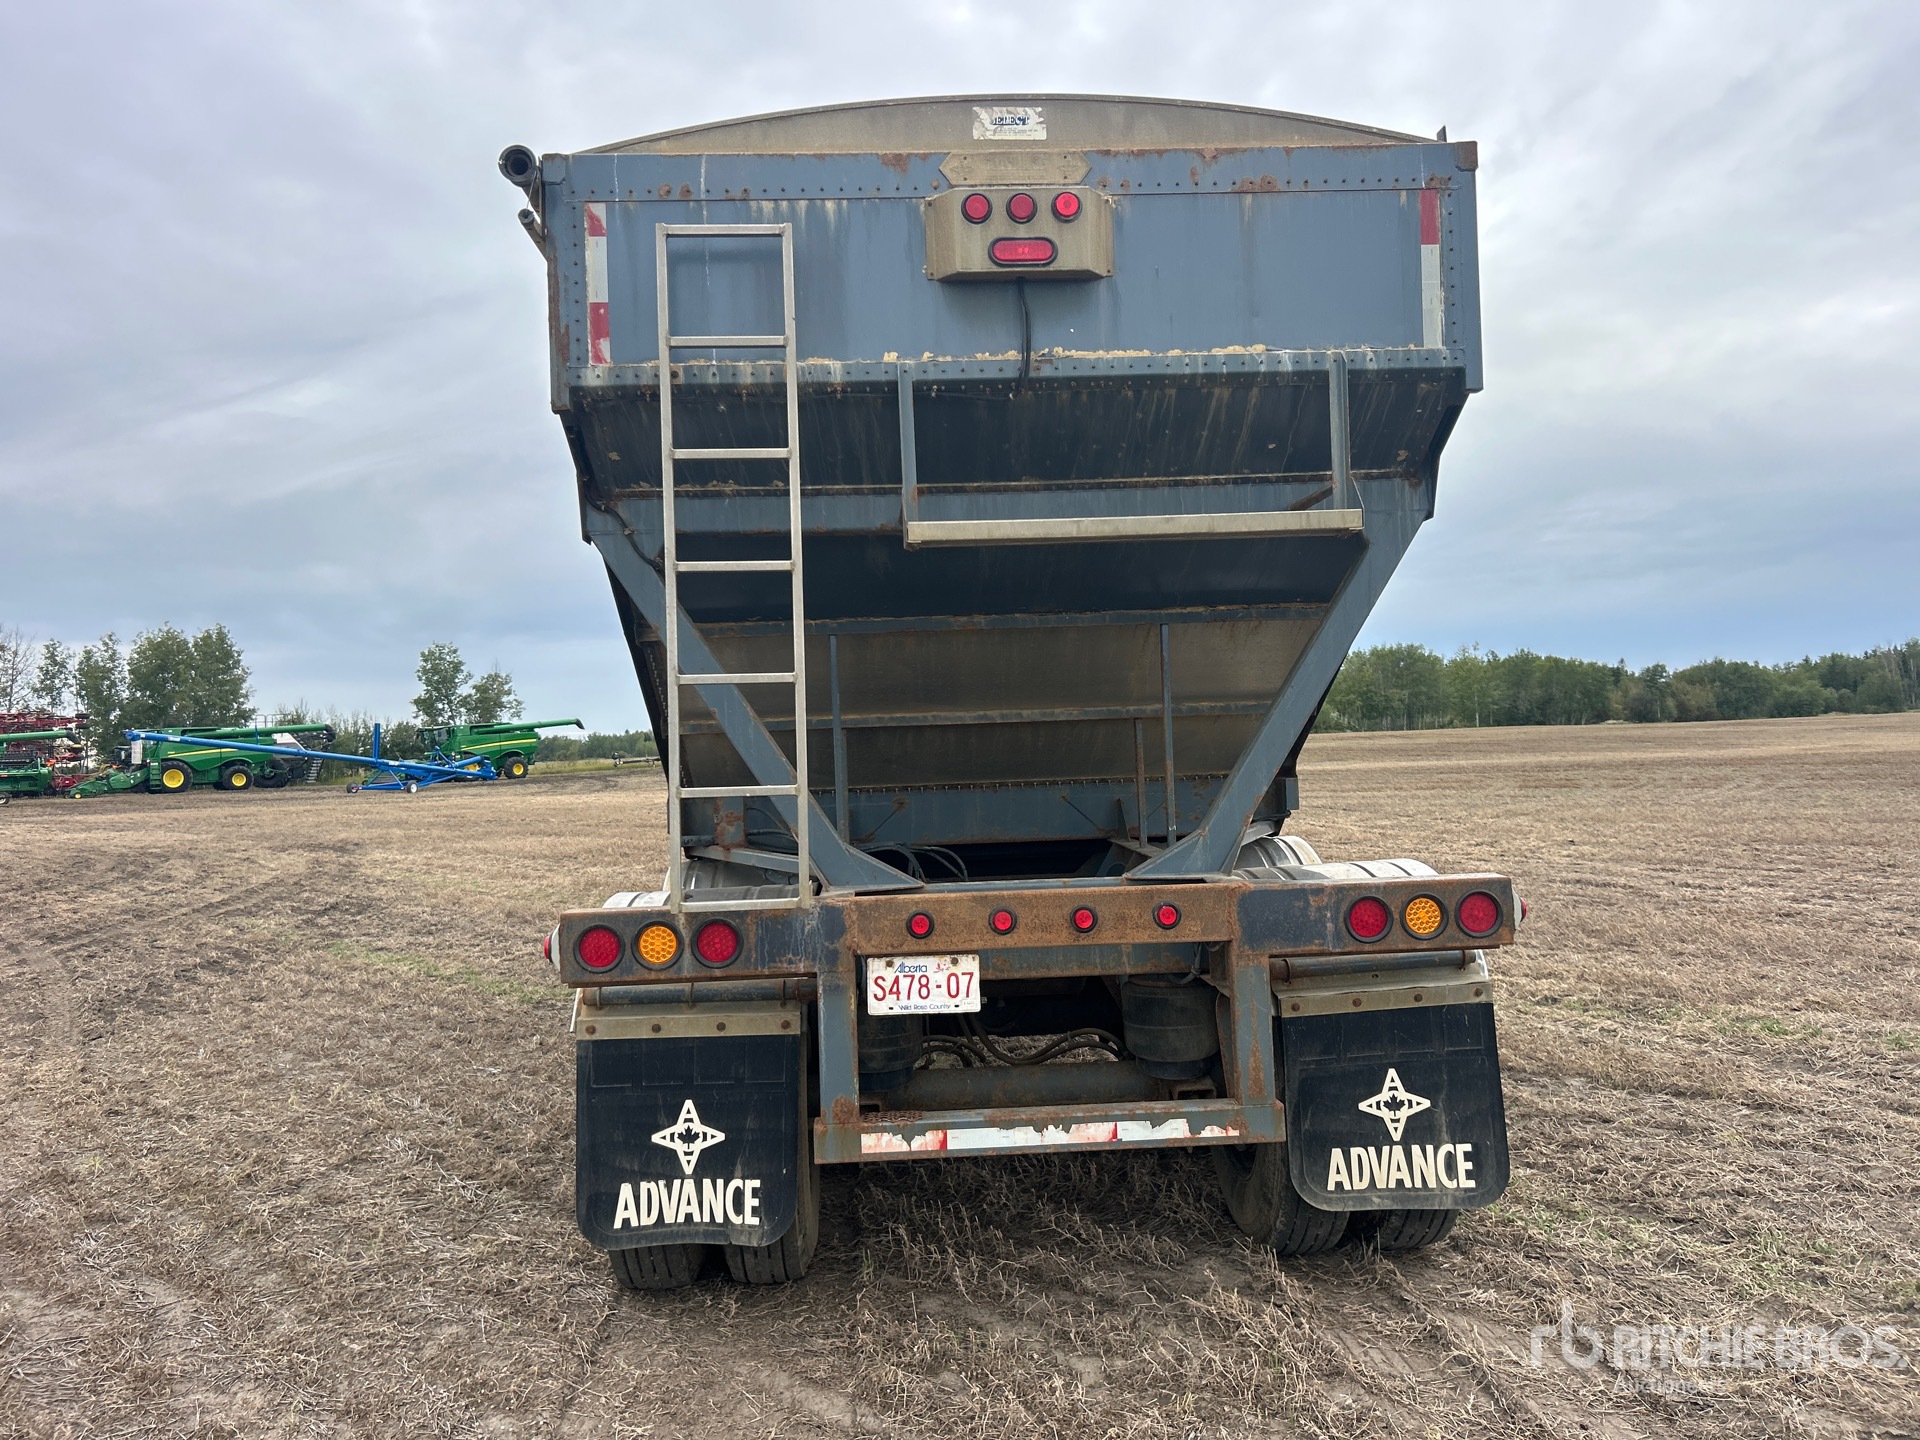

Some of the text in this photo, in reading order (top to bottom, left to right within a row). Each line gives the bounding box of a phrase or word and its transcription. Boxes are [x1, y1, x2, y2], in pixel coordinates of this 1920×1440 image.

[894, 961, 928, 973] Alberta
[1327, 1143, 1476, 1191] ADVANCE
[613, 1178, 761, 1229] ADVANCE
